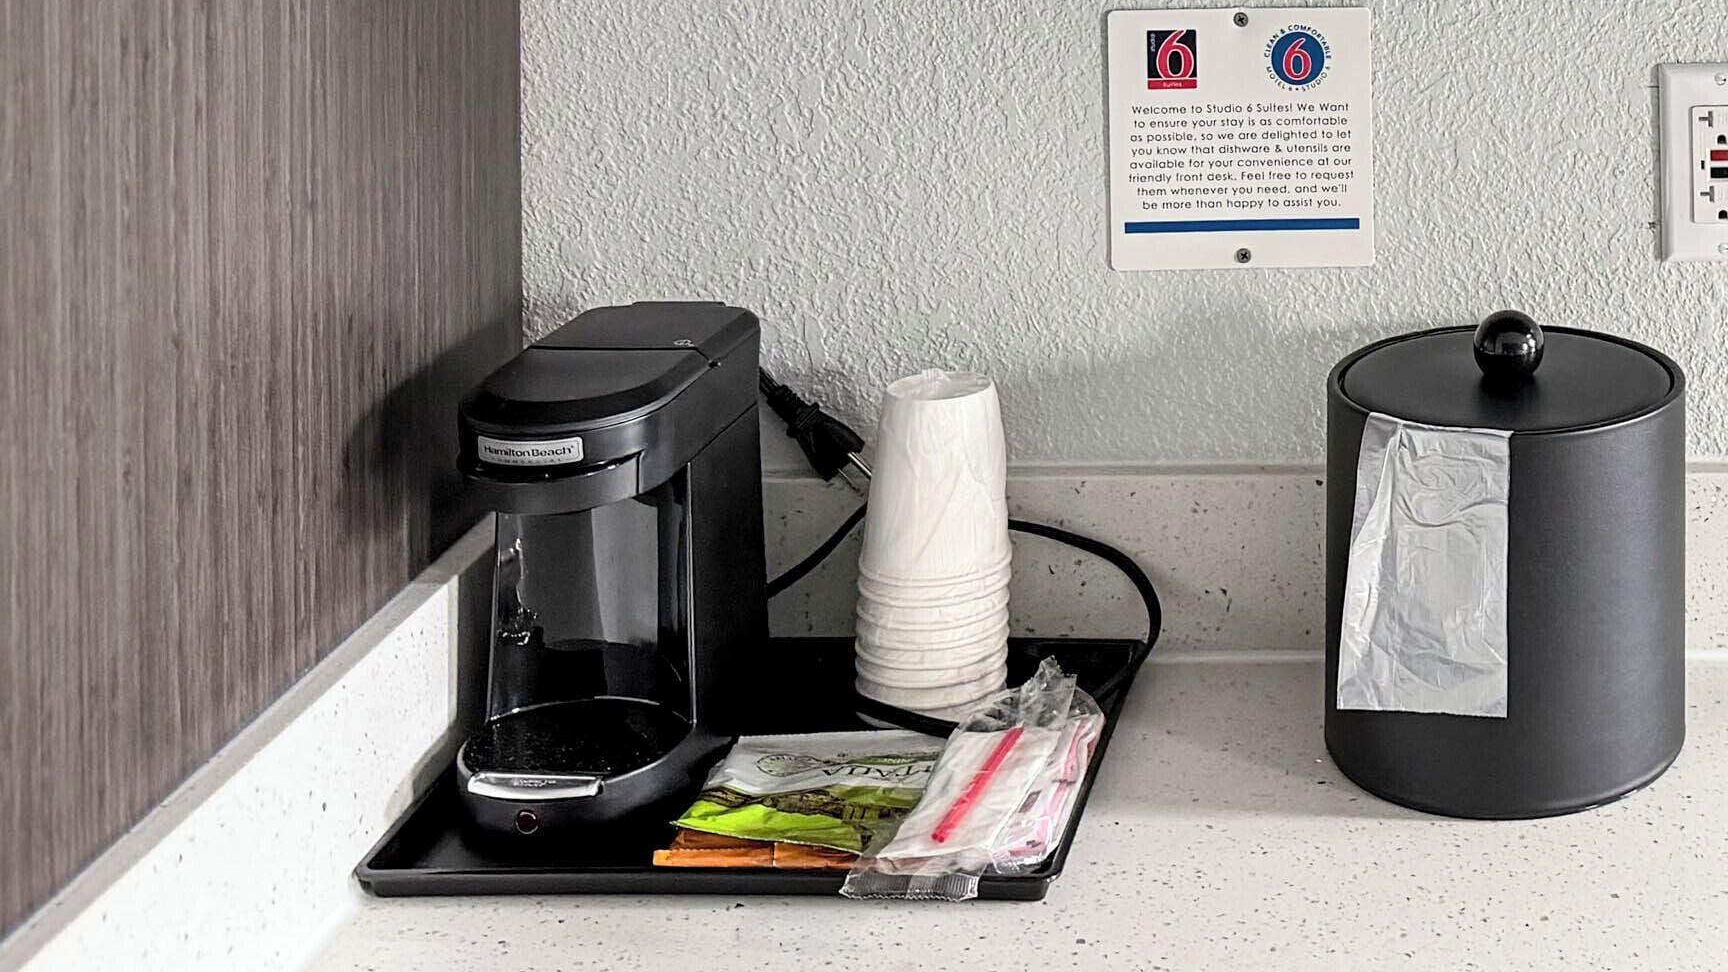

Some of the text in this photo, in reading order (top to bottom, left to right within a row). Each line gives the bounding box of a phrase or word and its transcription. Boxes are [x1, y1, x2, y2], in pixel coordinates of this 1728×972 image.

[1264, 33, 1279, 58] CLEAN
[1287, 24, 1332, 59] COMFORTABLE
[1156, 29, 1194, 79] 6
[1282, 37, 1312, 81] 6
[1302, 72, 1328, 92] STUDIO
[1131, 105, 1187, 115] Welcome
[1191, 105, 1203, 114] to
[1206, 104, 1243, 114] Studio
[1246, 103, 1253, 112] 6
[1297, 103, 1315, 112] We
[1319, 103, 1349, 112] Want
[1134, 116, 1348, 129] to ensure your stay is as comfortable
[1130, 134, 1143, 142] as
[1201, 133, 1213, 141] so
[1218, 132, 1234, 140] we
[1239, 132, 1257, 140] are
[1261, 130, 1317, 141] delighted
[1322, 130, 1333, 139] to
[1337, 130, 1351, 139] let
[1131, 143, 1351, 157] you know that dishware & utensils are
[1129, 157, 1351, 169] available for your convenience at our
[1129, 173, 1172, 184] friendly
[1176, 172, 1202, 182] front
[1241, 171, 1265, 180] Feel
[1269, 171, 1291, 180] free
[1296, 171, 1307, 180] to
[1311, 170, 1354, 181] request
[1137, 187, 1167, 196] them
[1170, 187, 1228, 196] whenever
[1232, 187, 1253, 196] you
[1294, 184, 1317, 194] and
[1142, 201, 1158, 210] be
[1162, 201, 1192, 210] more
[1196, 200, 1222, 209] than
[1227, 199, 1264, 209] happy
[1268, 198, 1279, 208] to
[1283, 198, 1313, 207] assist
